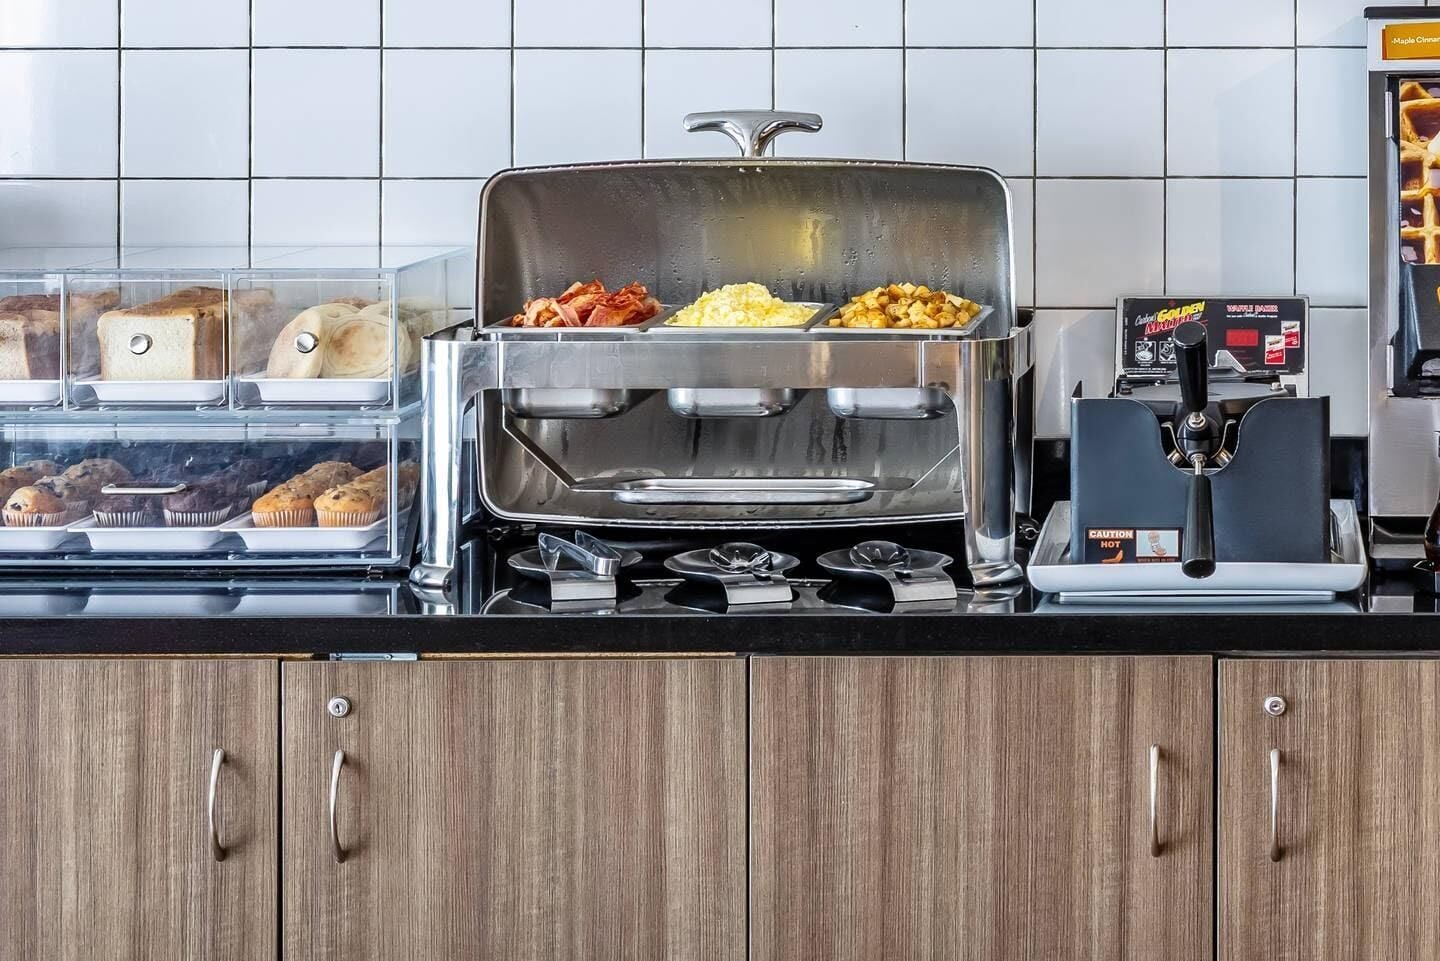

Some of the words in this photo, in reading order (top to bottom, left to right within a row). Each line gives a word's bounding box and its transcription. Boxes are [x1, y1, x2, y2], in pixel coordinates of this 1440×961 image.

[1157, 300, 1206, 323] GOLDEN
[1089, 530, 1134, 539] CAUTION
[1100, 540, 1121, 548] HOT
